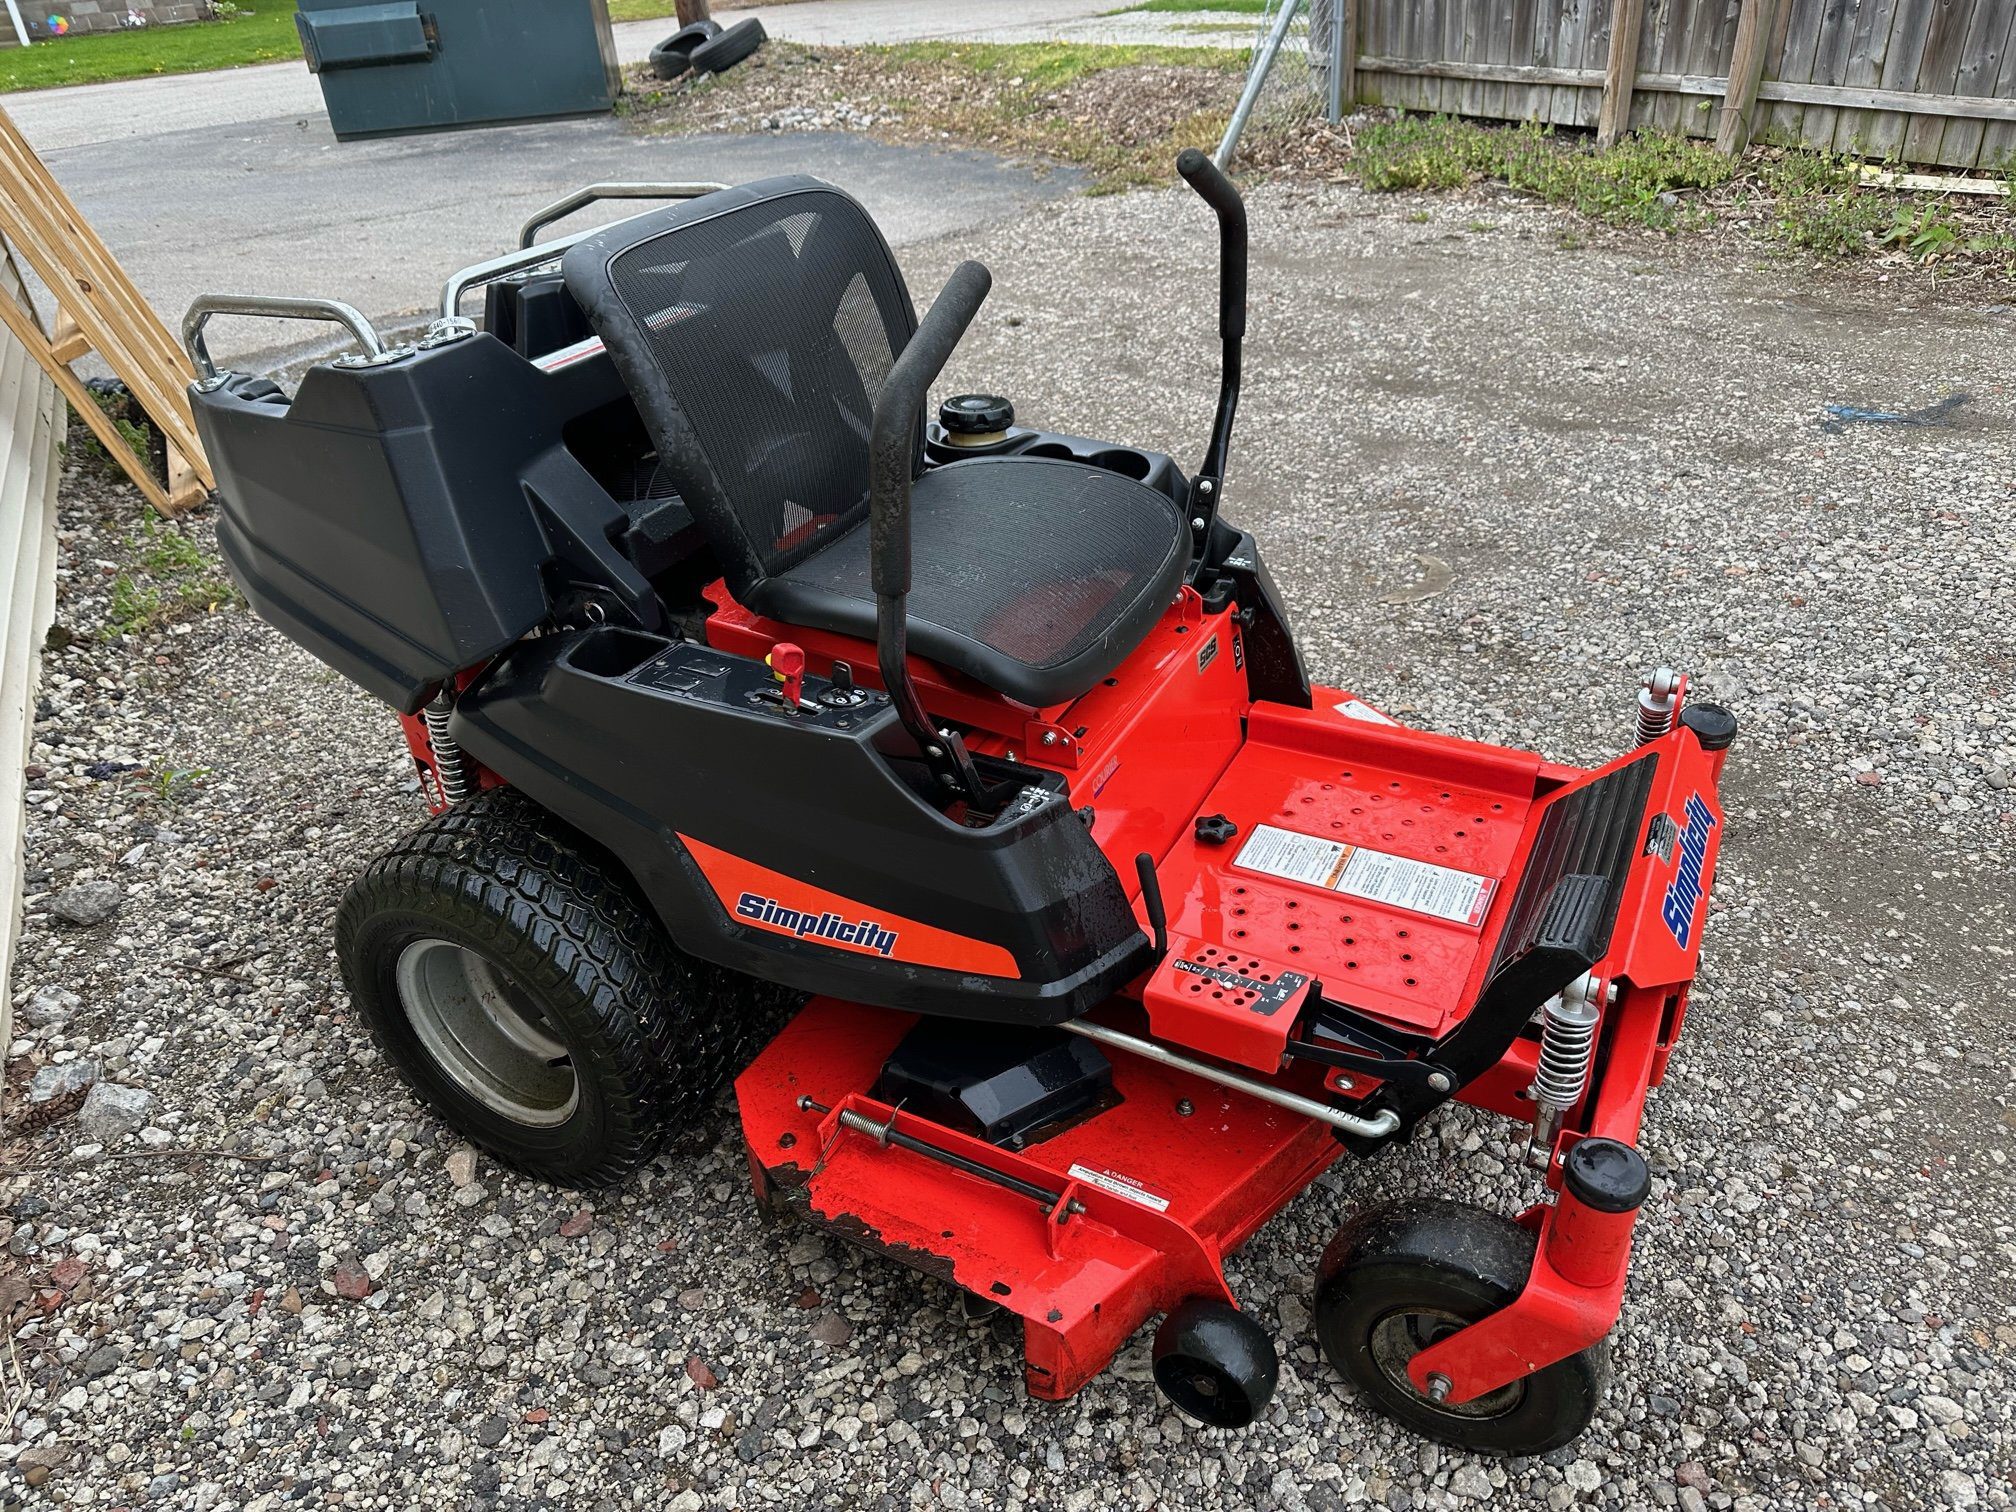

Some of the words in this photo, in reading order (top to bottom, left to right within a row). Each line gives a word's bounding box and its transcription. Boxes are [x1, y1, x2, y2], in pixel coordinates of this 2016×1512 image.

[1662, 791, 1716, 951] Simplicity
[736, 892, 899, 956] Simplicity
[1111, 1170, 1143, 1188] DANGER
